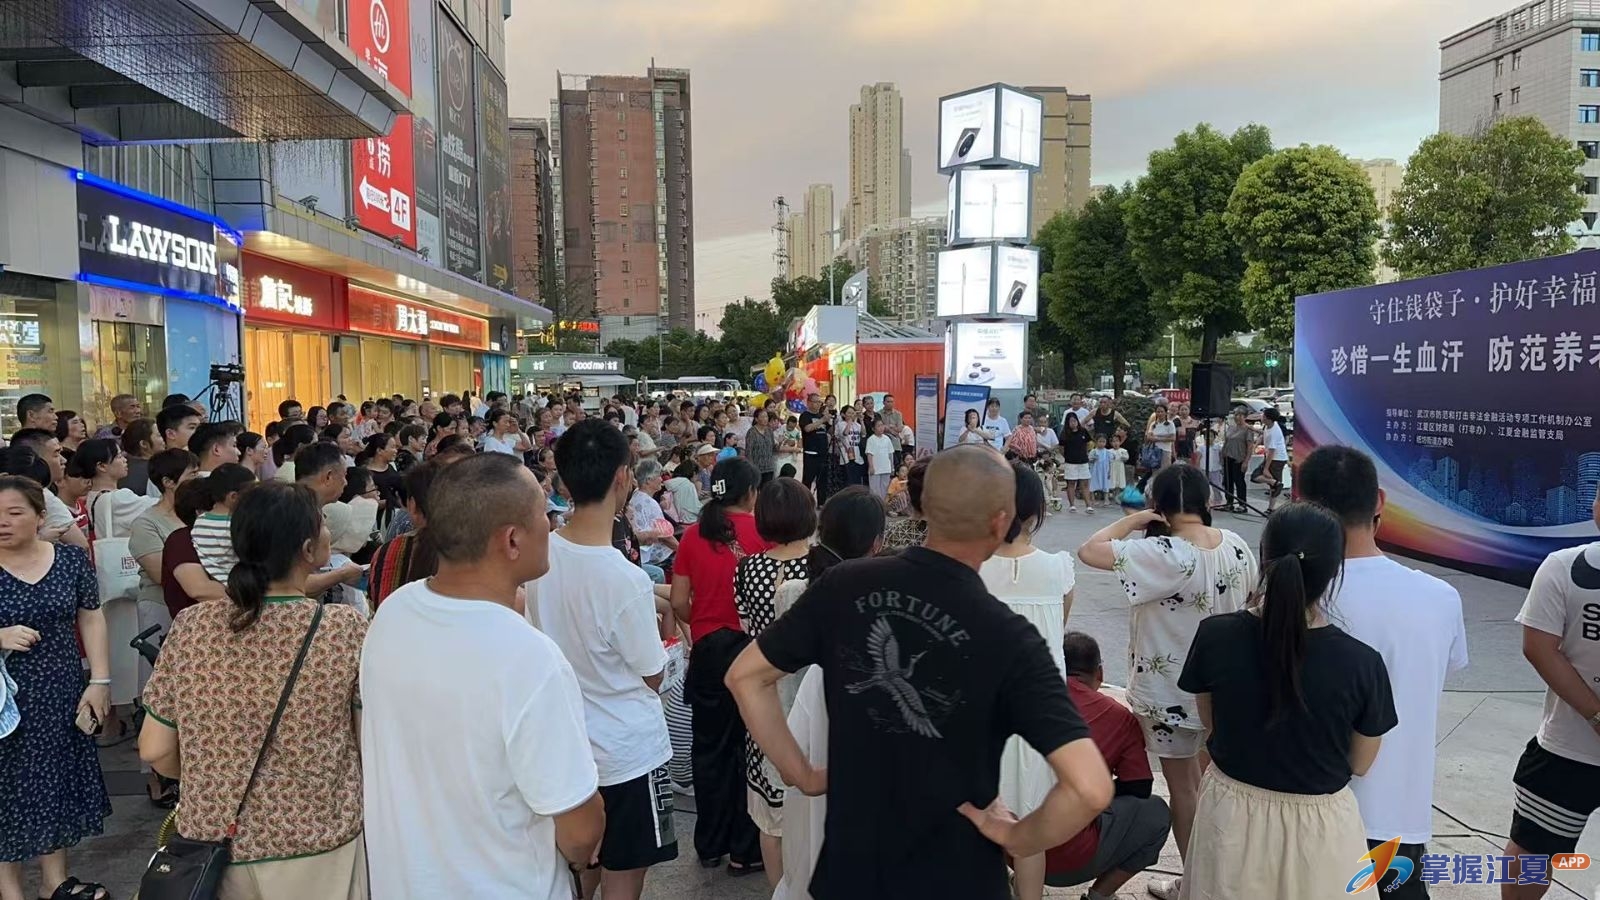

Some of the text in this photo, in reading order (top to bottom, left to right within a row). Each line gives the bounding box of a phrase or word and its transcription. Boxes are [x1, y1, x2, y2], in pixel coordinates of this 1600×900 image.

[394, 196, 407, 223] 4F
[108, 214, 217, 276] LAWSON
[1331, 340, 1464, 375] 珍惜一生血汗
[854, 590, 971, 647] FORTUNE
